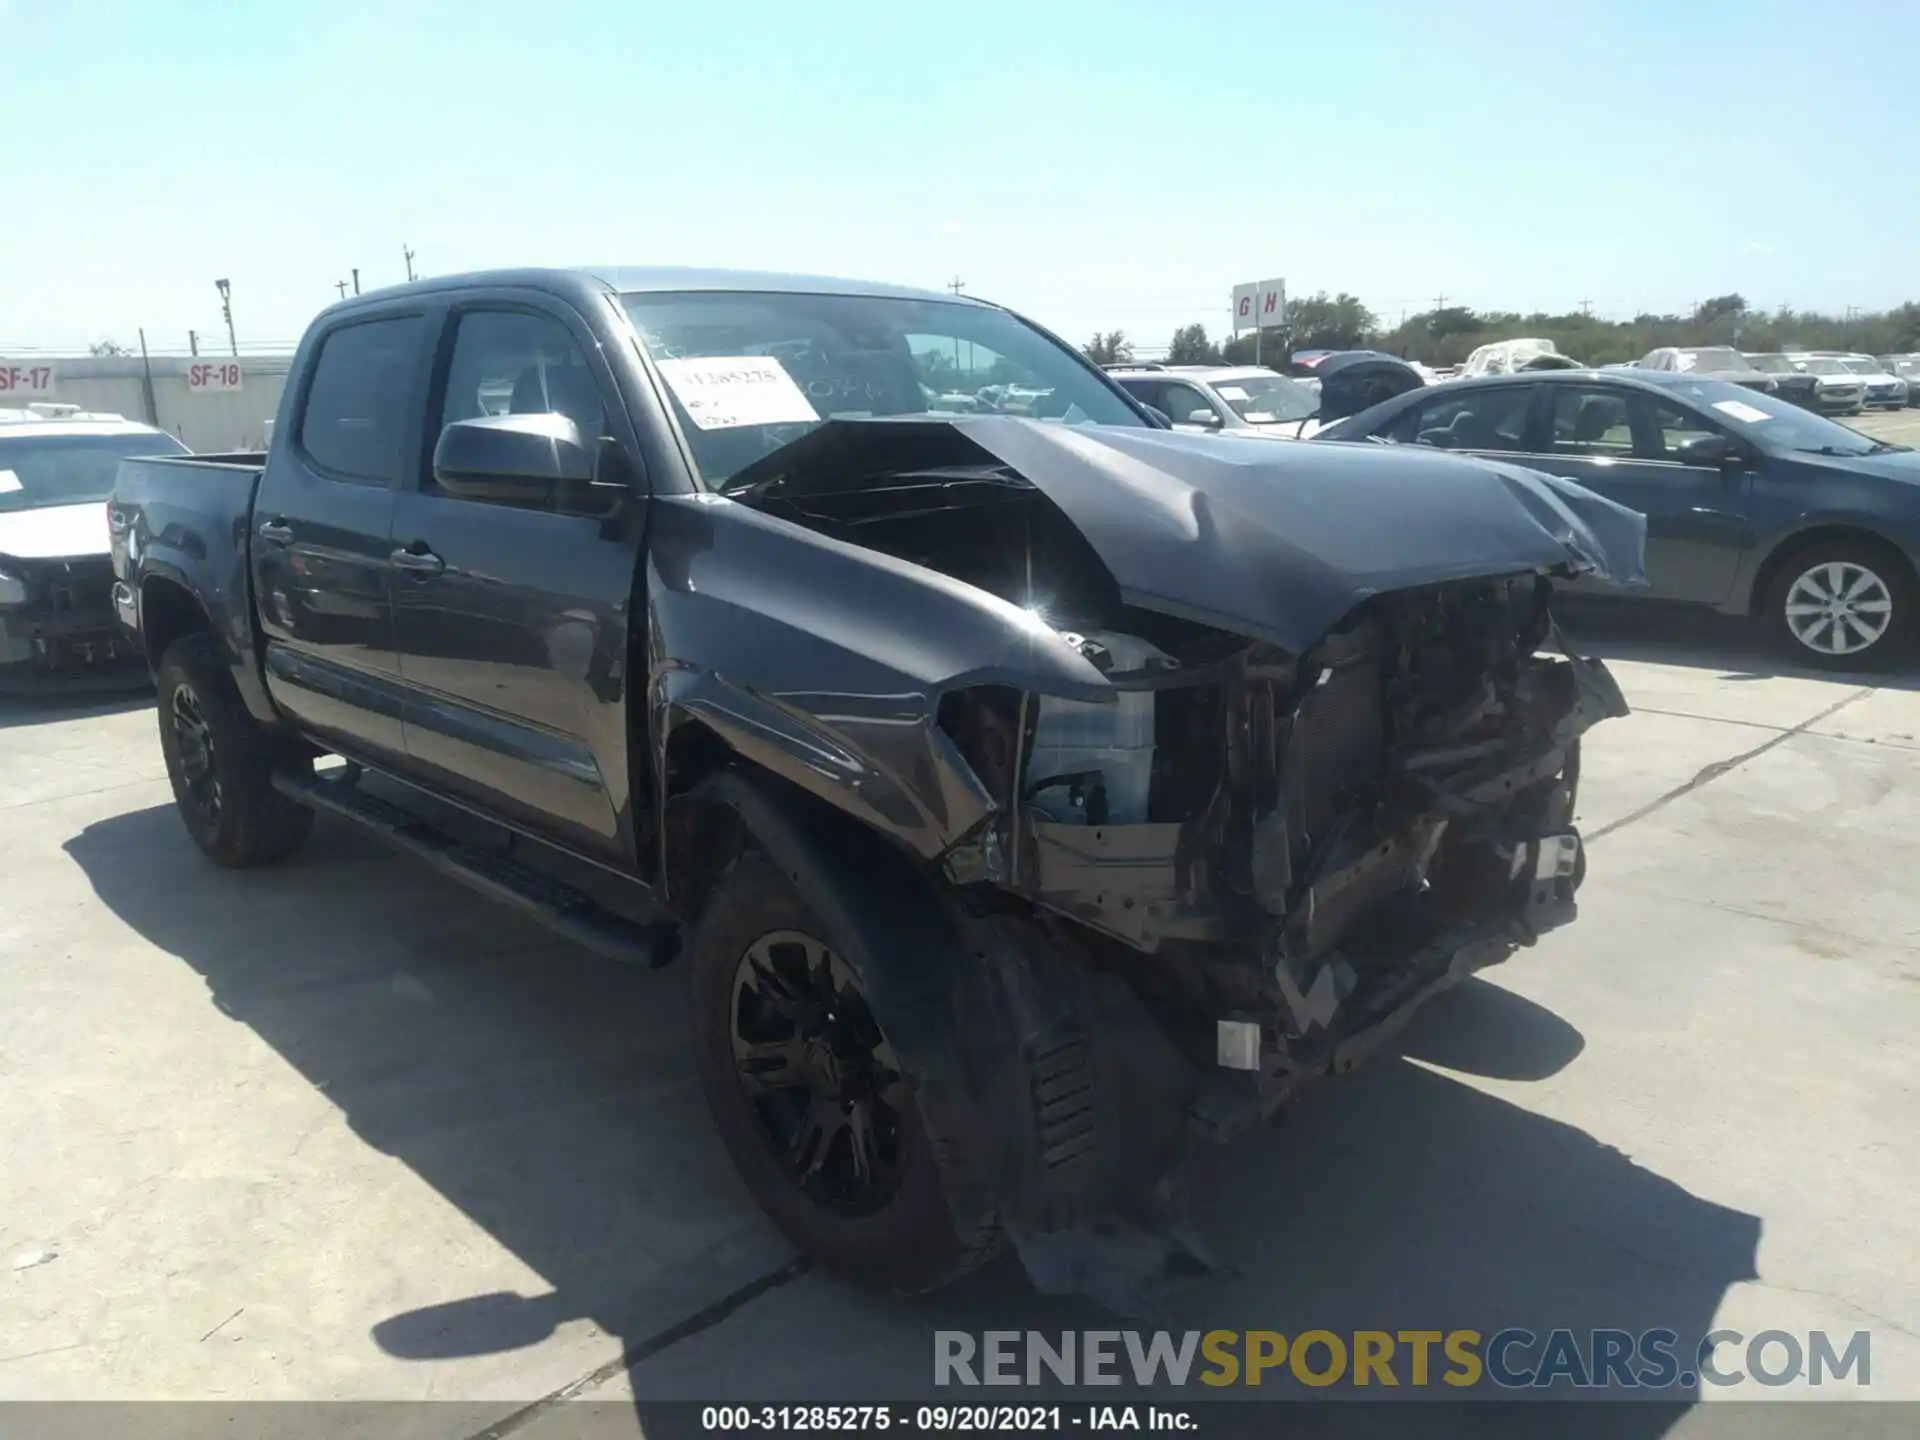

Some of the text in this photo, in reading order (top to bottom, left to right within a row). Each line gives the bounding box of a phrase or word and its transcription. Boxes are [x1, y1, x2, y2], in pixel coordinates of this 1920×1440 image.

[1239, 297, 1250, 316] G
[1264, 292, 1277, 313] H
[190, 364, 239, 386] SF-18
